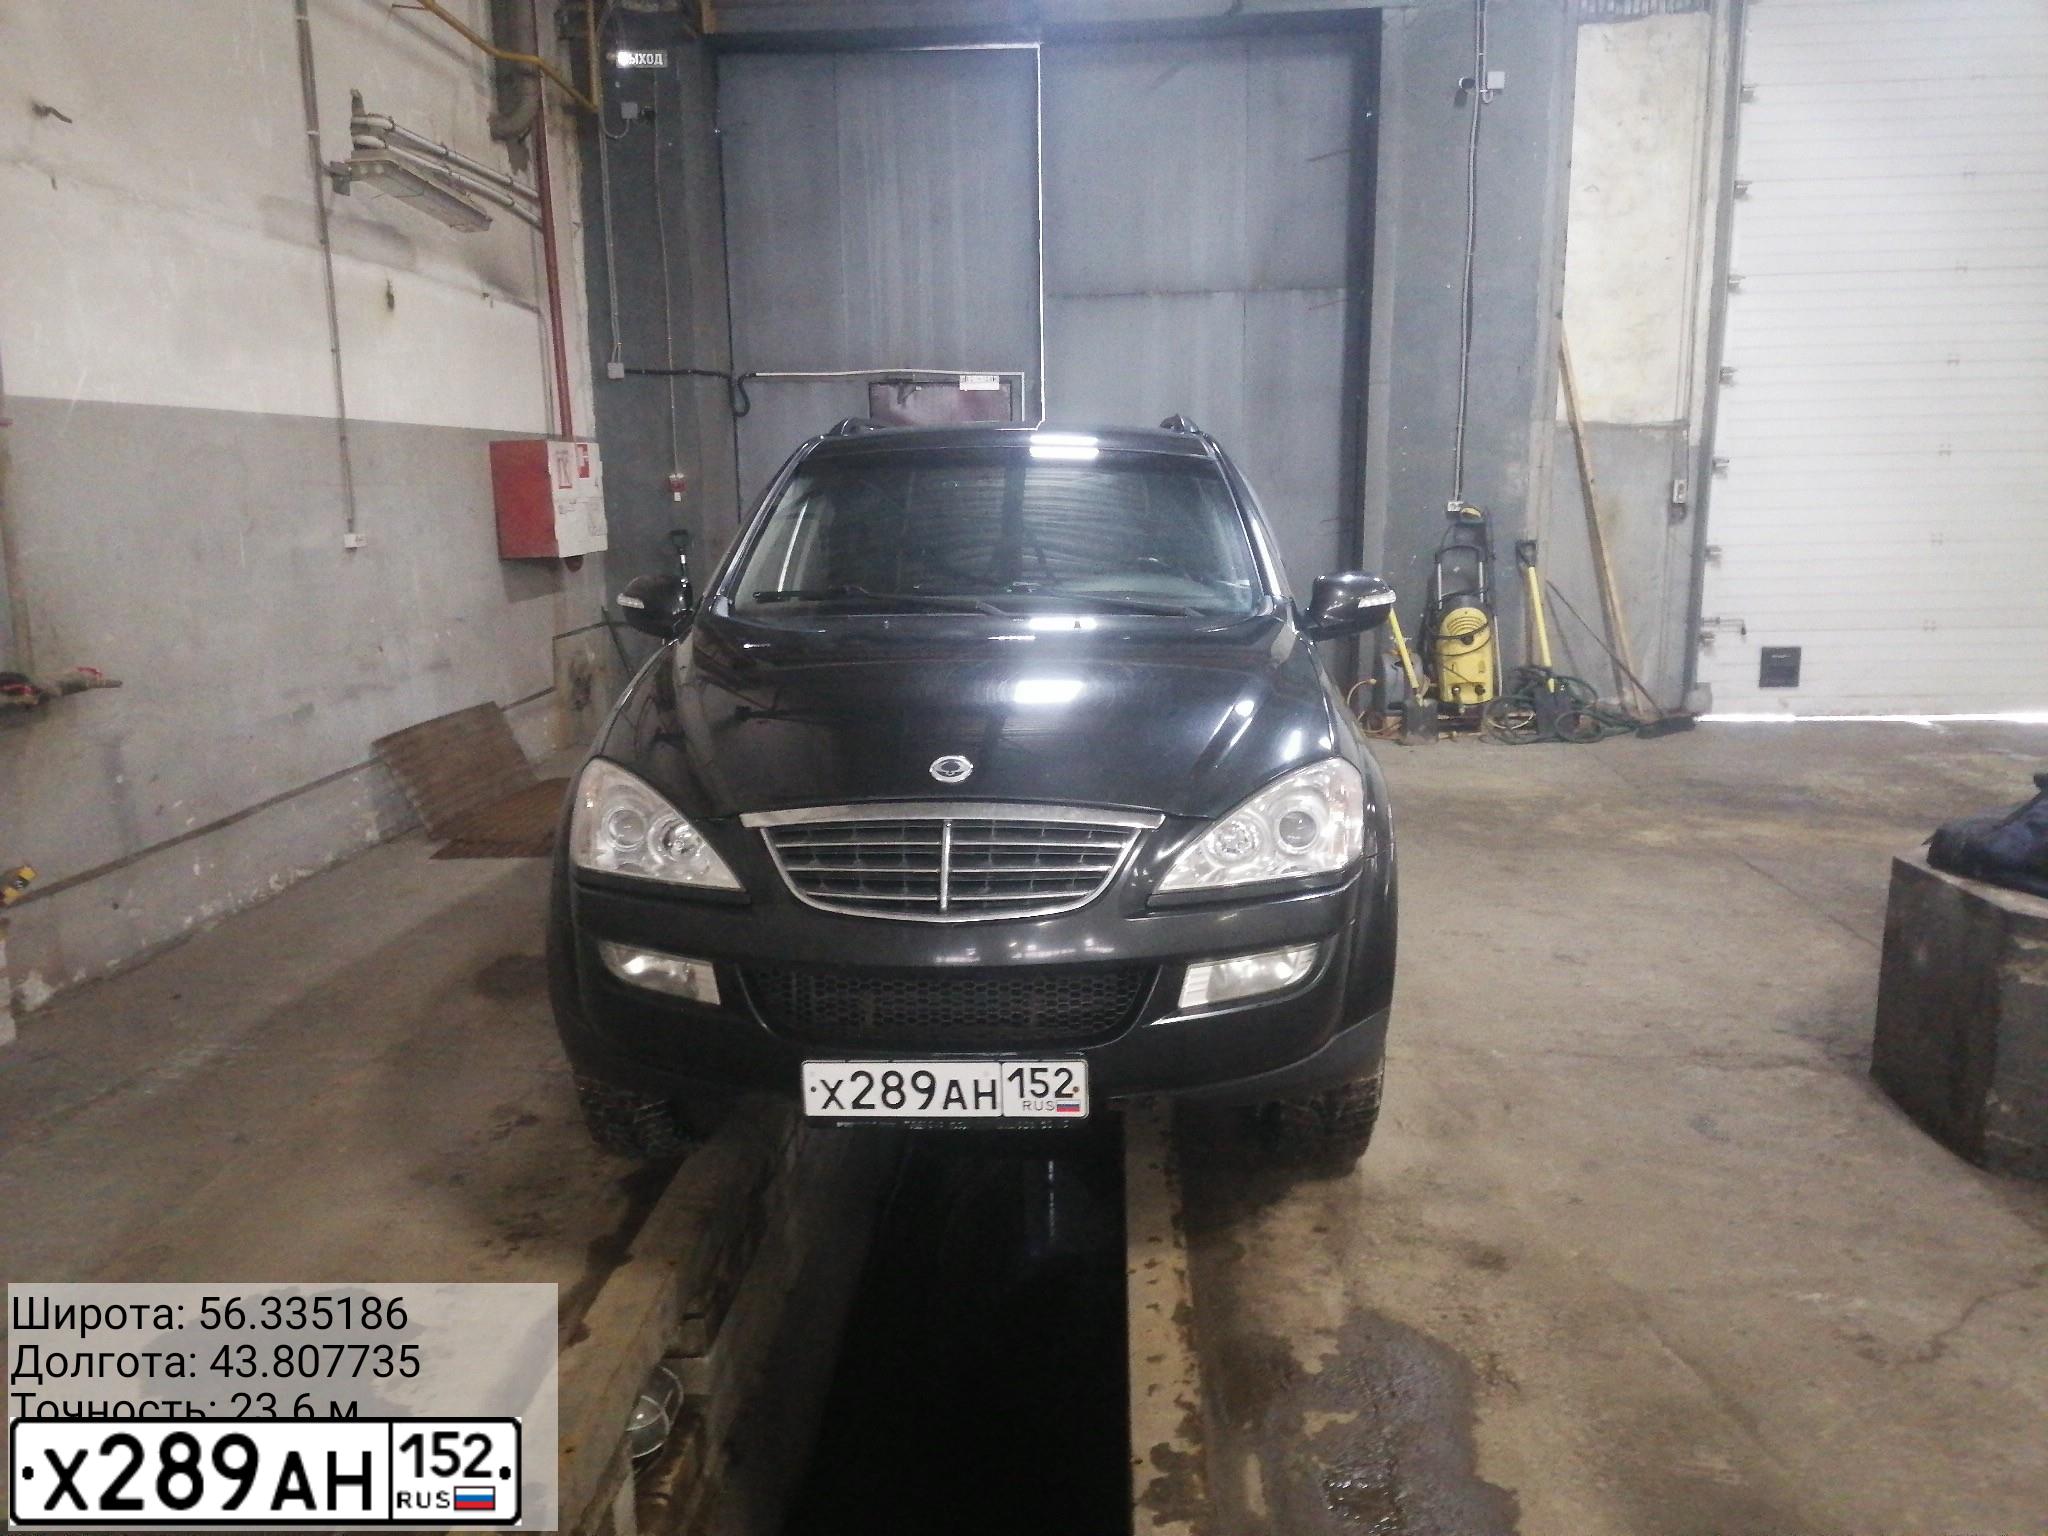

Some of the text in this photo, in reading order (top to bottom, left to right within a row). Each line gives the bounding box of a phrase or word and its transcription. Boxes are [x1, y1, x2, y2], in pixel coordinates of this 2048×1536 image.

[619, 53, 663, 65] ЫХОД
[820, 1067, 1074, 1110] Х289АН 152
[1022, 1100, 1055, 1112] RUS
